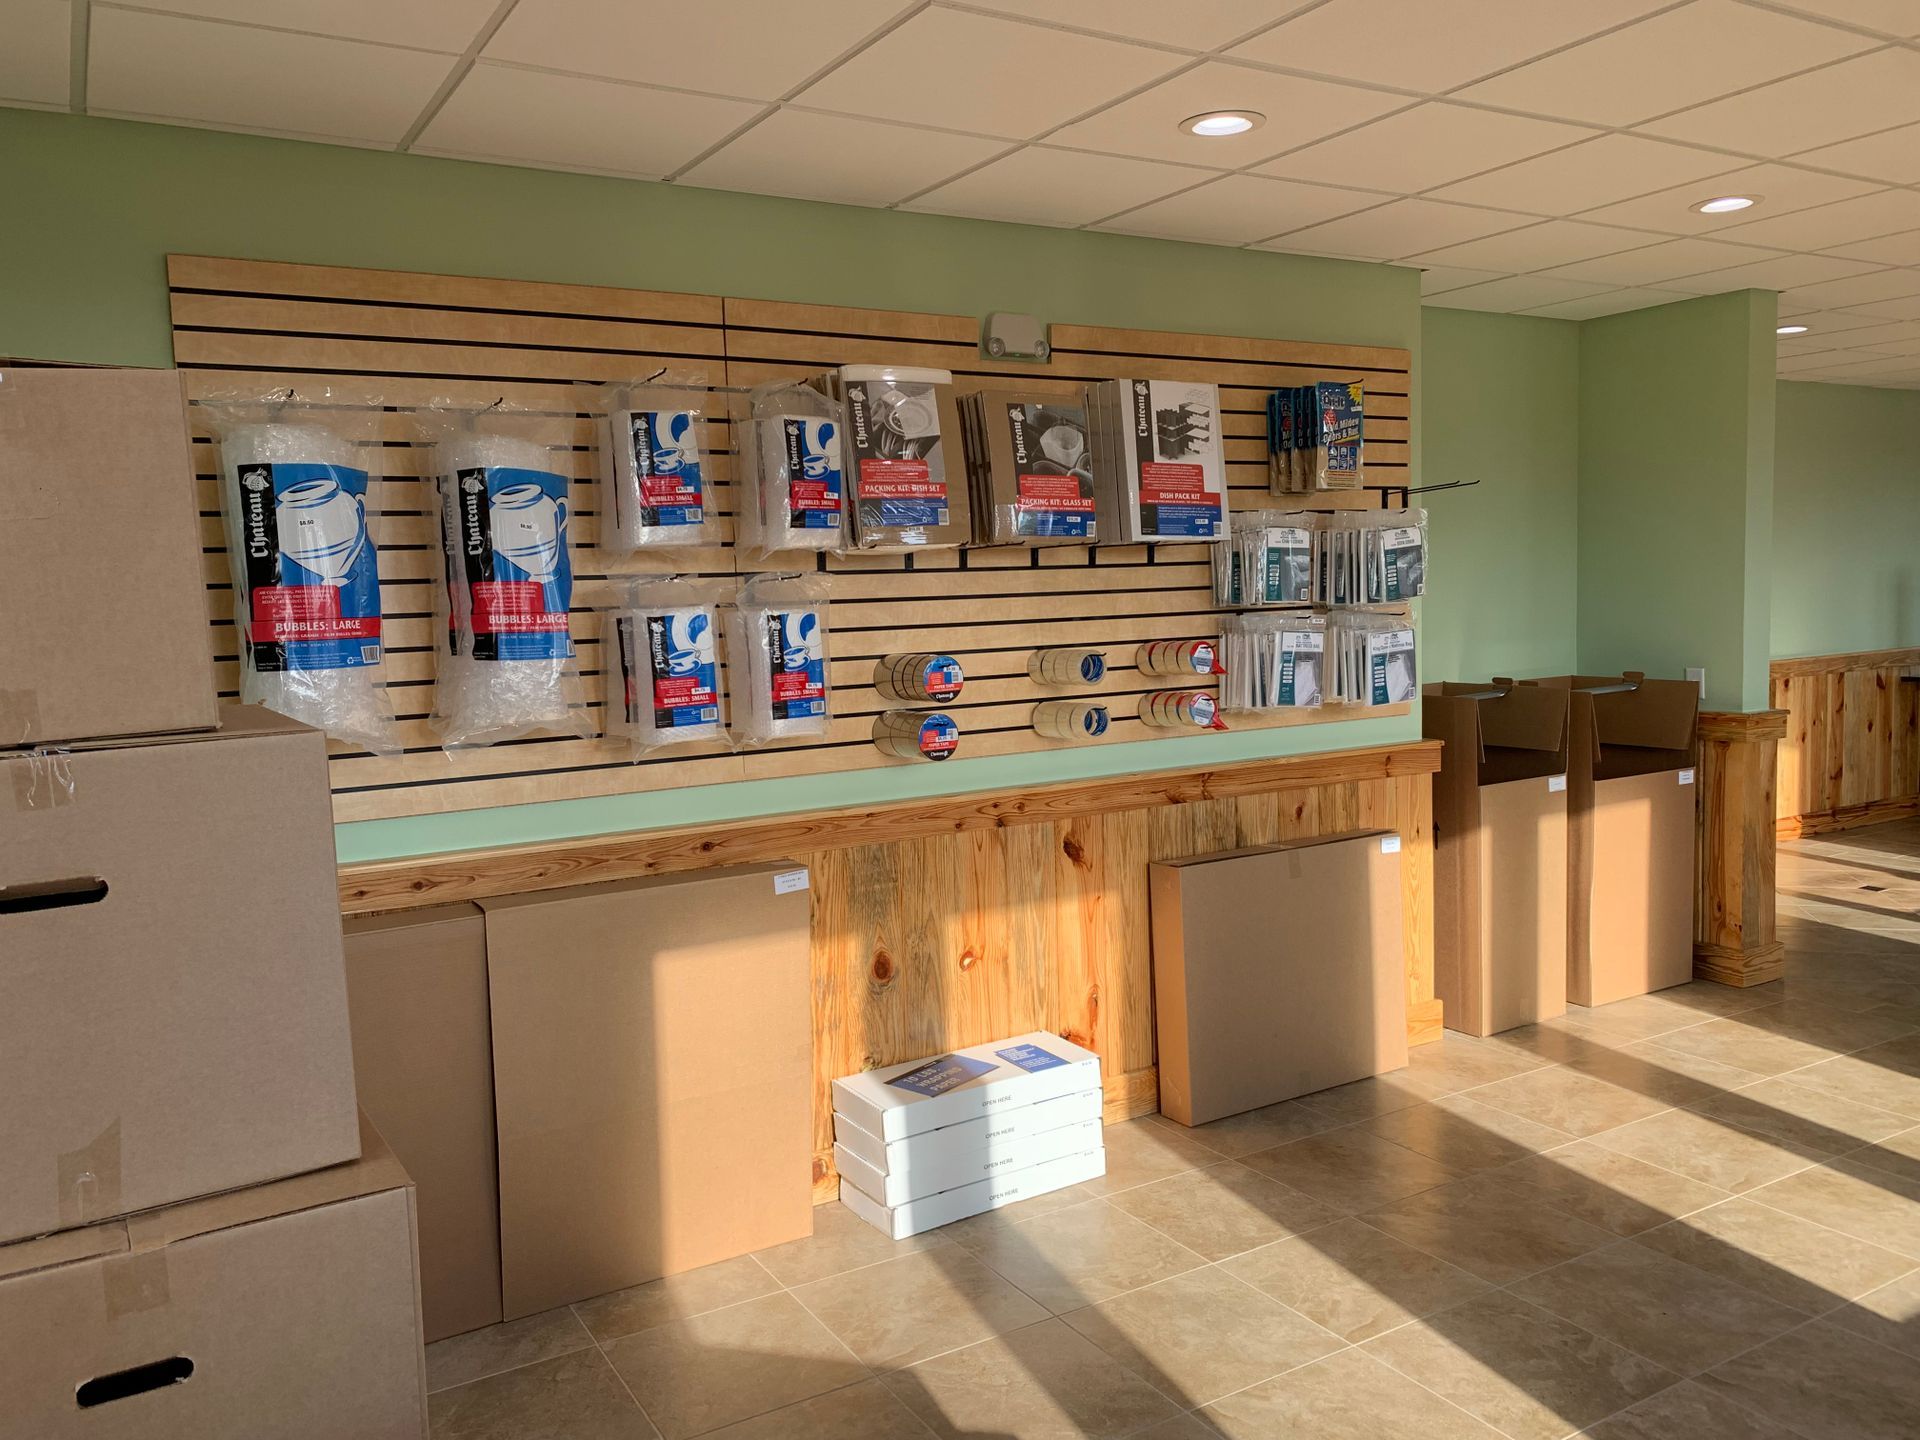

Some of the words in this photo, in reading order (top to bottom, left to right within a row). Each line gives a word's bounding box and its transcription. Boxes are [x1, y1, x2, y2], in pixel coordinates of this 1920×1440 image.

[856, 402, 869, 448] Chateau
[1138, 396, 1148, 437] Chateau
[1340, 418, 1359, 429] Mildew
[1017, 422, 1027, 464] Chateau
[1343, 429, 1347, 437] &
[791, 436, 800, 470] Chateau
[248, 492, 269, 558] Chateau
[466, 494, 483, 556] Chateau
[275, 621, 329, 632] BUBBLES:
[332, 620, 361, 630] LARGE
[489, 614, 534, 624] BUBBLES:
[537, 614, 567, 623] LARGE
[655, 633, 665, 668] Chateau
[773, 631, 781, 664] Chateau
[916, 1067, 962, 1087] WRAPPING
[982, 1099, 997, 1107] OPEN
[998, 1095, 1012, 1103] HERE
[1001, 1127, 1015, 1135] HERE
[1000, 1158, 1013, 1166] HERE
[988, 1192, 1004, 1201] OPEN
[1005, 1188, 1018, 1197] HERE
